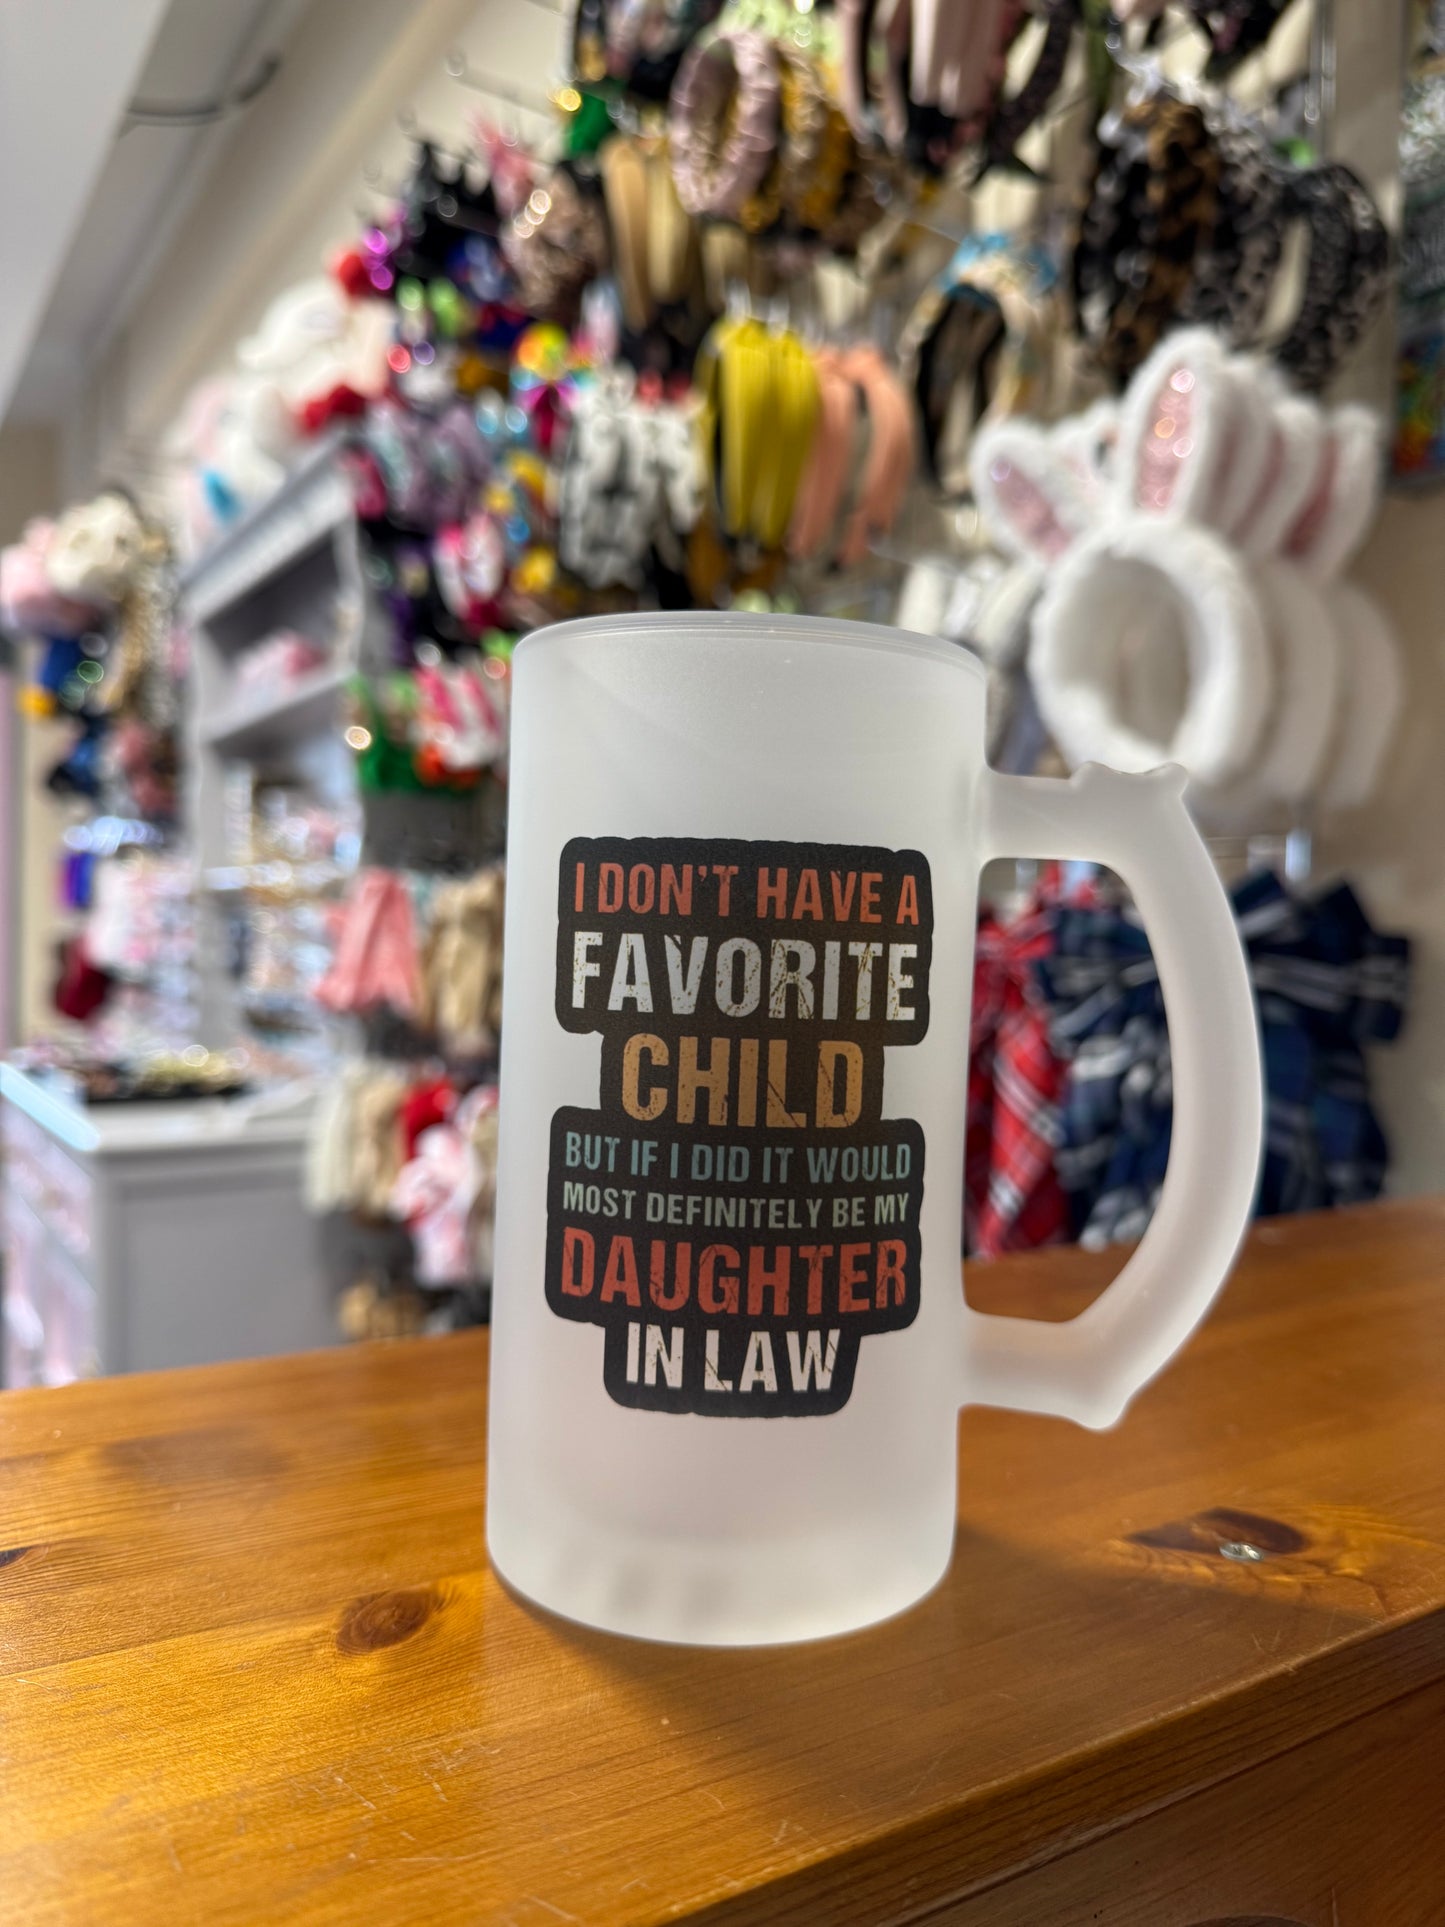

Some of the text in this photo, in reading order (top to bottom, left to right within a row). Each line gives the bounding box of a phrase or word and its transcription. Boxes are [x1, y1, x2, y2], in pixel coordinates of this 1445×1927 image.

[574, 862, 920, 926] I DON'T HAVE A
[571, 931, 918, 1021] FAVORITE
[621, 1032, 864, 1129] CHILD
[565, 1131, 912, 1183] BUT IF I DID IT WOULD
[562, 1180, 910, 1229] MOST DEFINITELY BE MY
[560, 1225, 908, 1316] DAUGHTER
[625, 1321, 841, 1393] IN LAW
